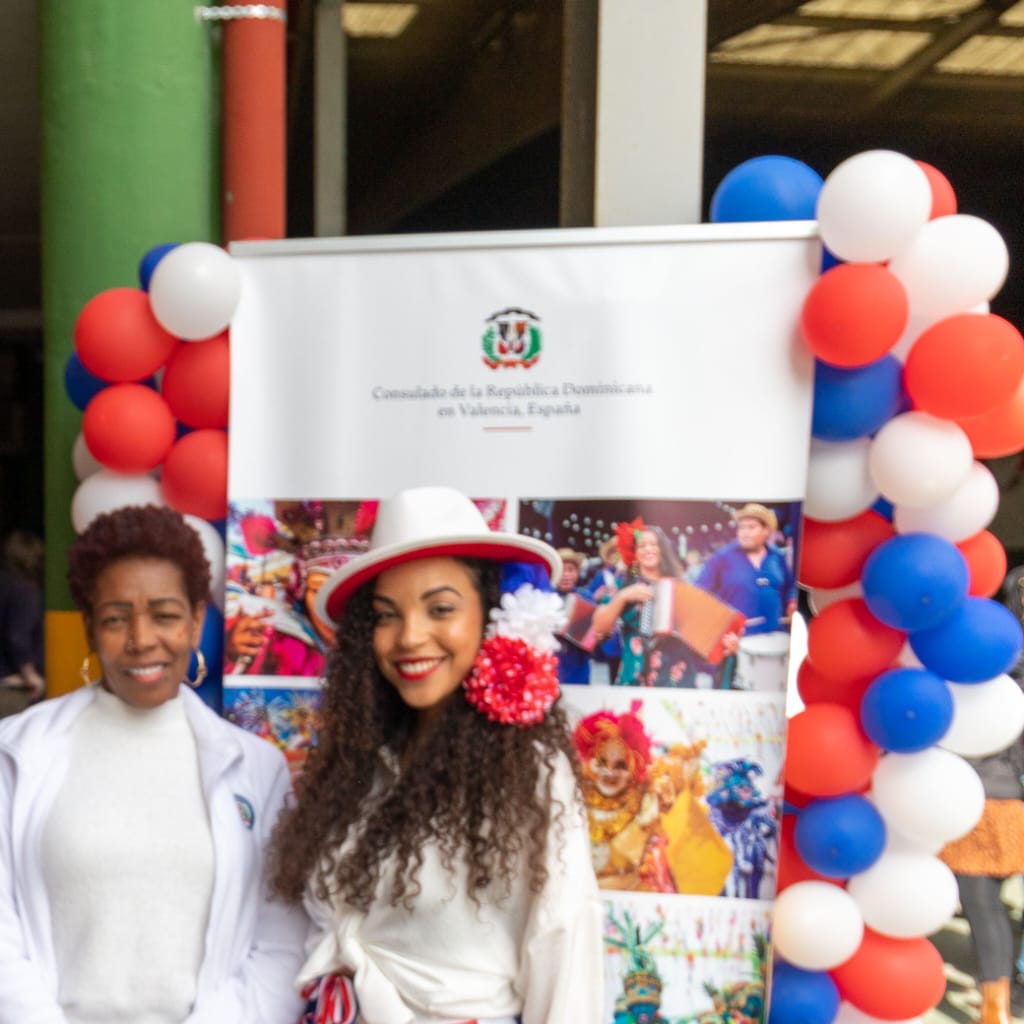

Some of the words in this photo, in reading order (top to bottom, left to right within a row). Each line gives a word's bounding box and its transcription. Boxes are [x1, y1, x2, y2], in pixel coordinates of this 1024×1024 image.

[372, 384, 447, 400] Consulado
[450, 384, 466, 398] de
[469, 384, 483, 398] la
[486, 382, 559, 400] República
[562, 381, 654, 395] Dominicana
[437, 405, 455, 417] en
[527, 401, 582, 418] España
